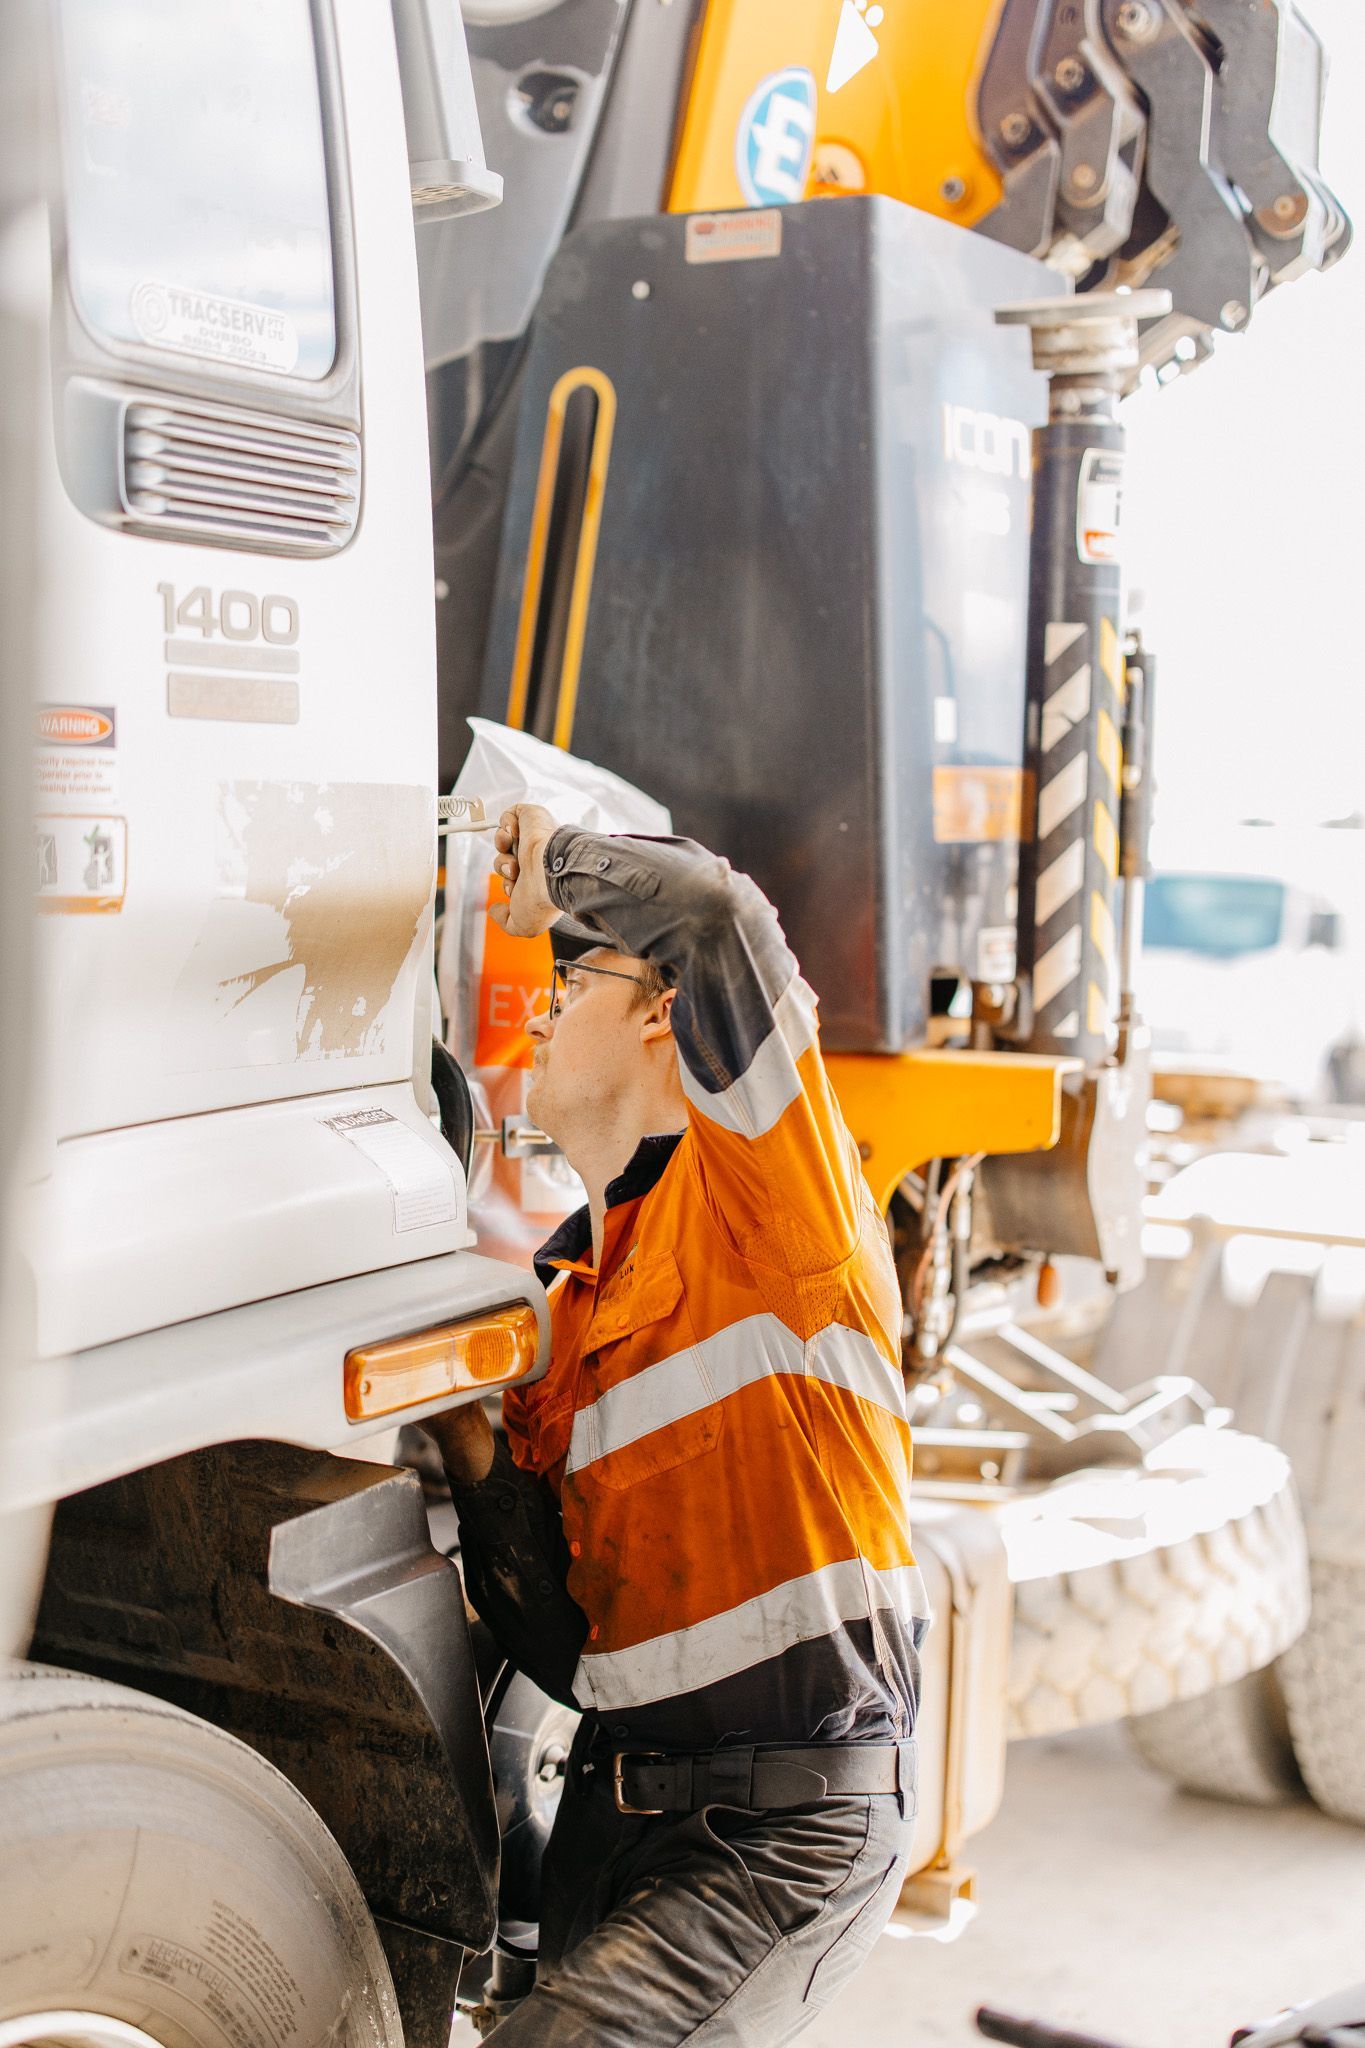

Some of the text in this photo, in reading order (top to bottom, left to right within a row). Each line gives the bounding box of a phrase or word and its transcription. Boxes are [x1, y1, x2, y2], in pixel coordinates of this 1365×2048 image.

[168, 294, 266, 336] TRACSERV
[199, 327, 253, 348] DUBBO
[157, 582, 299, 646] 1400
[40, 716, 100, 736] WARNING
